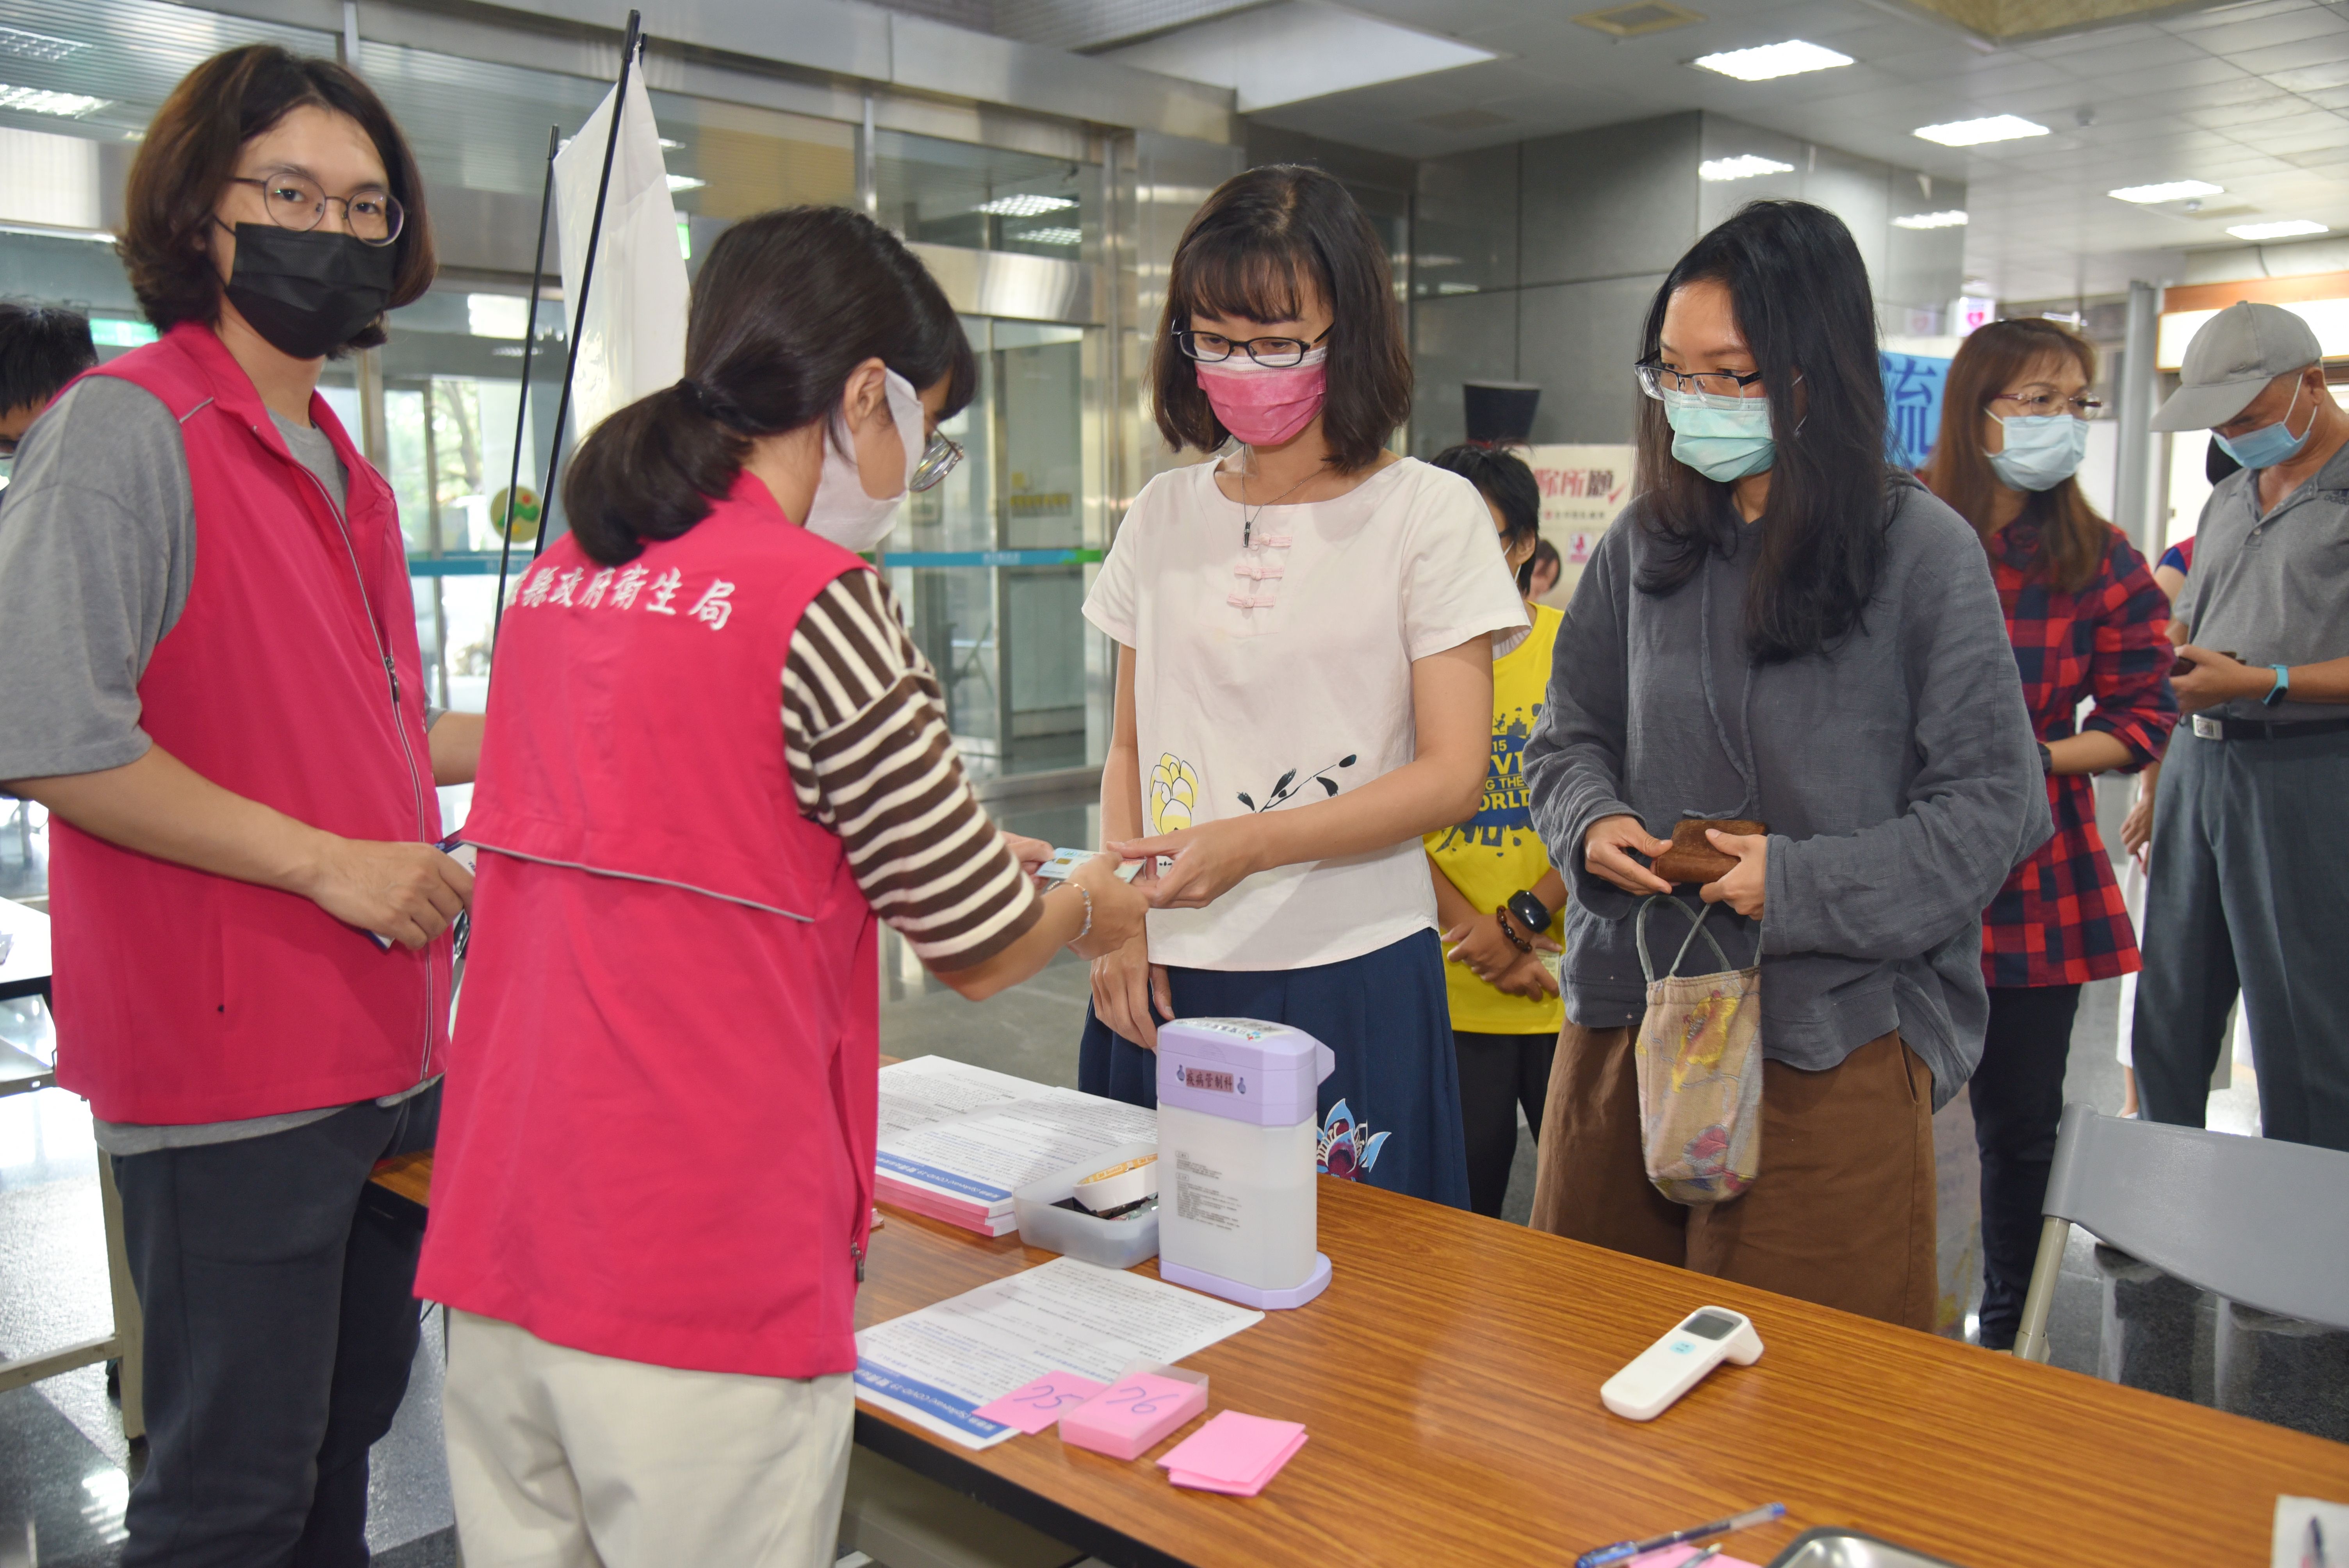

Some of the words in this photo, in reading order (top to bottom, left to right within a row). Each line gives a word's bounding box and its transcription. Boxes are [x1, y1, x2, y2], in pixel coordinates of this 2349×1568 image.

[1499, 776, 1525, 788] THE
[1187, 1070, 1232, 1090] 疾病管制科
